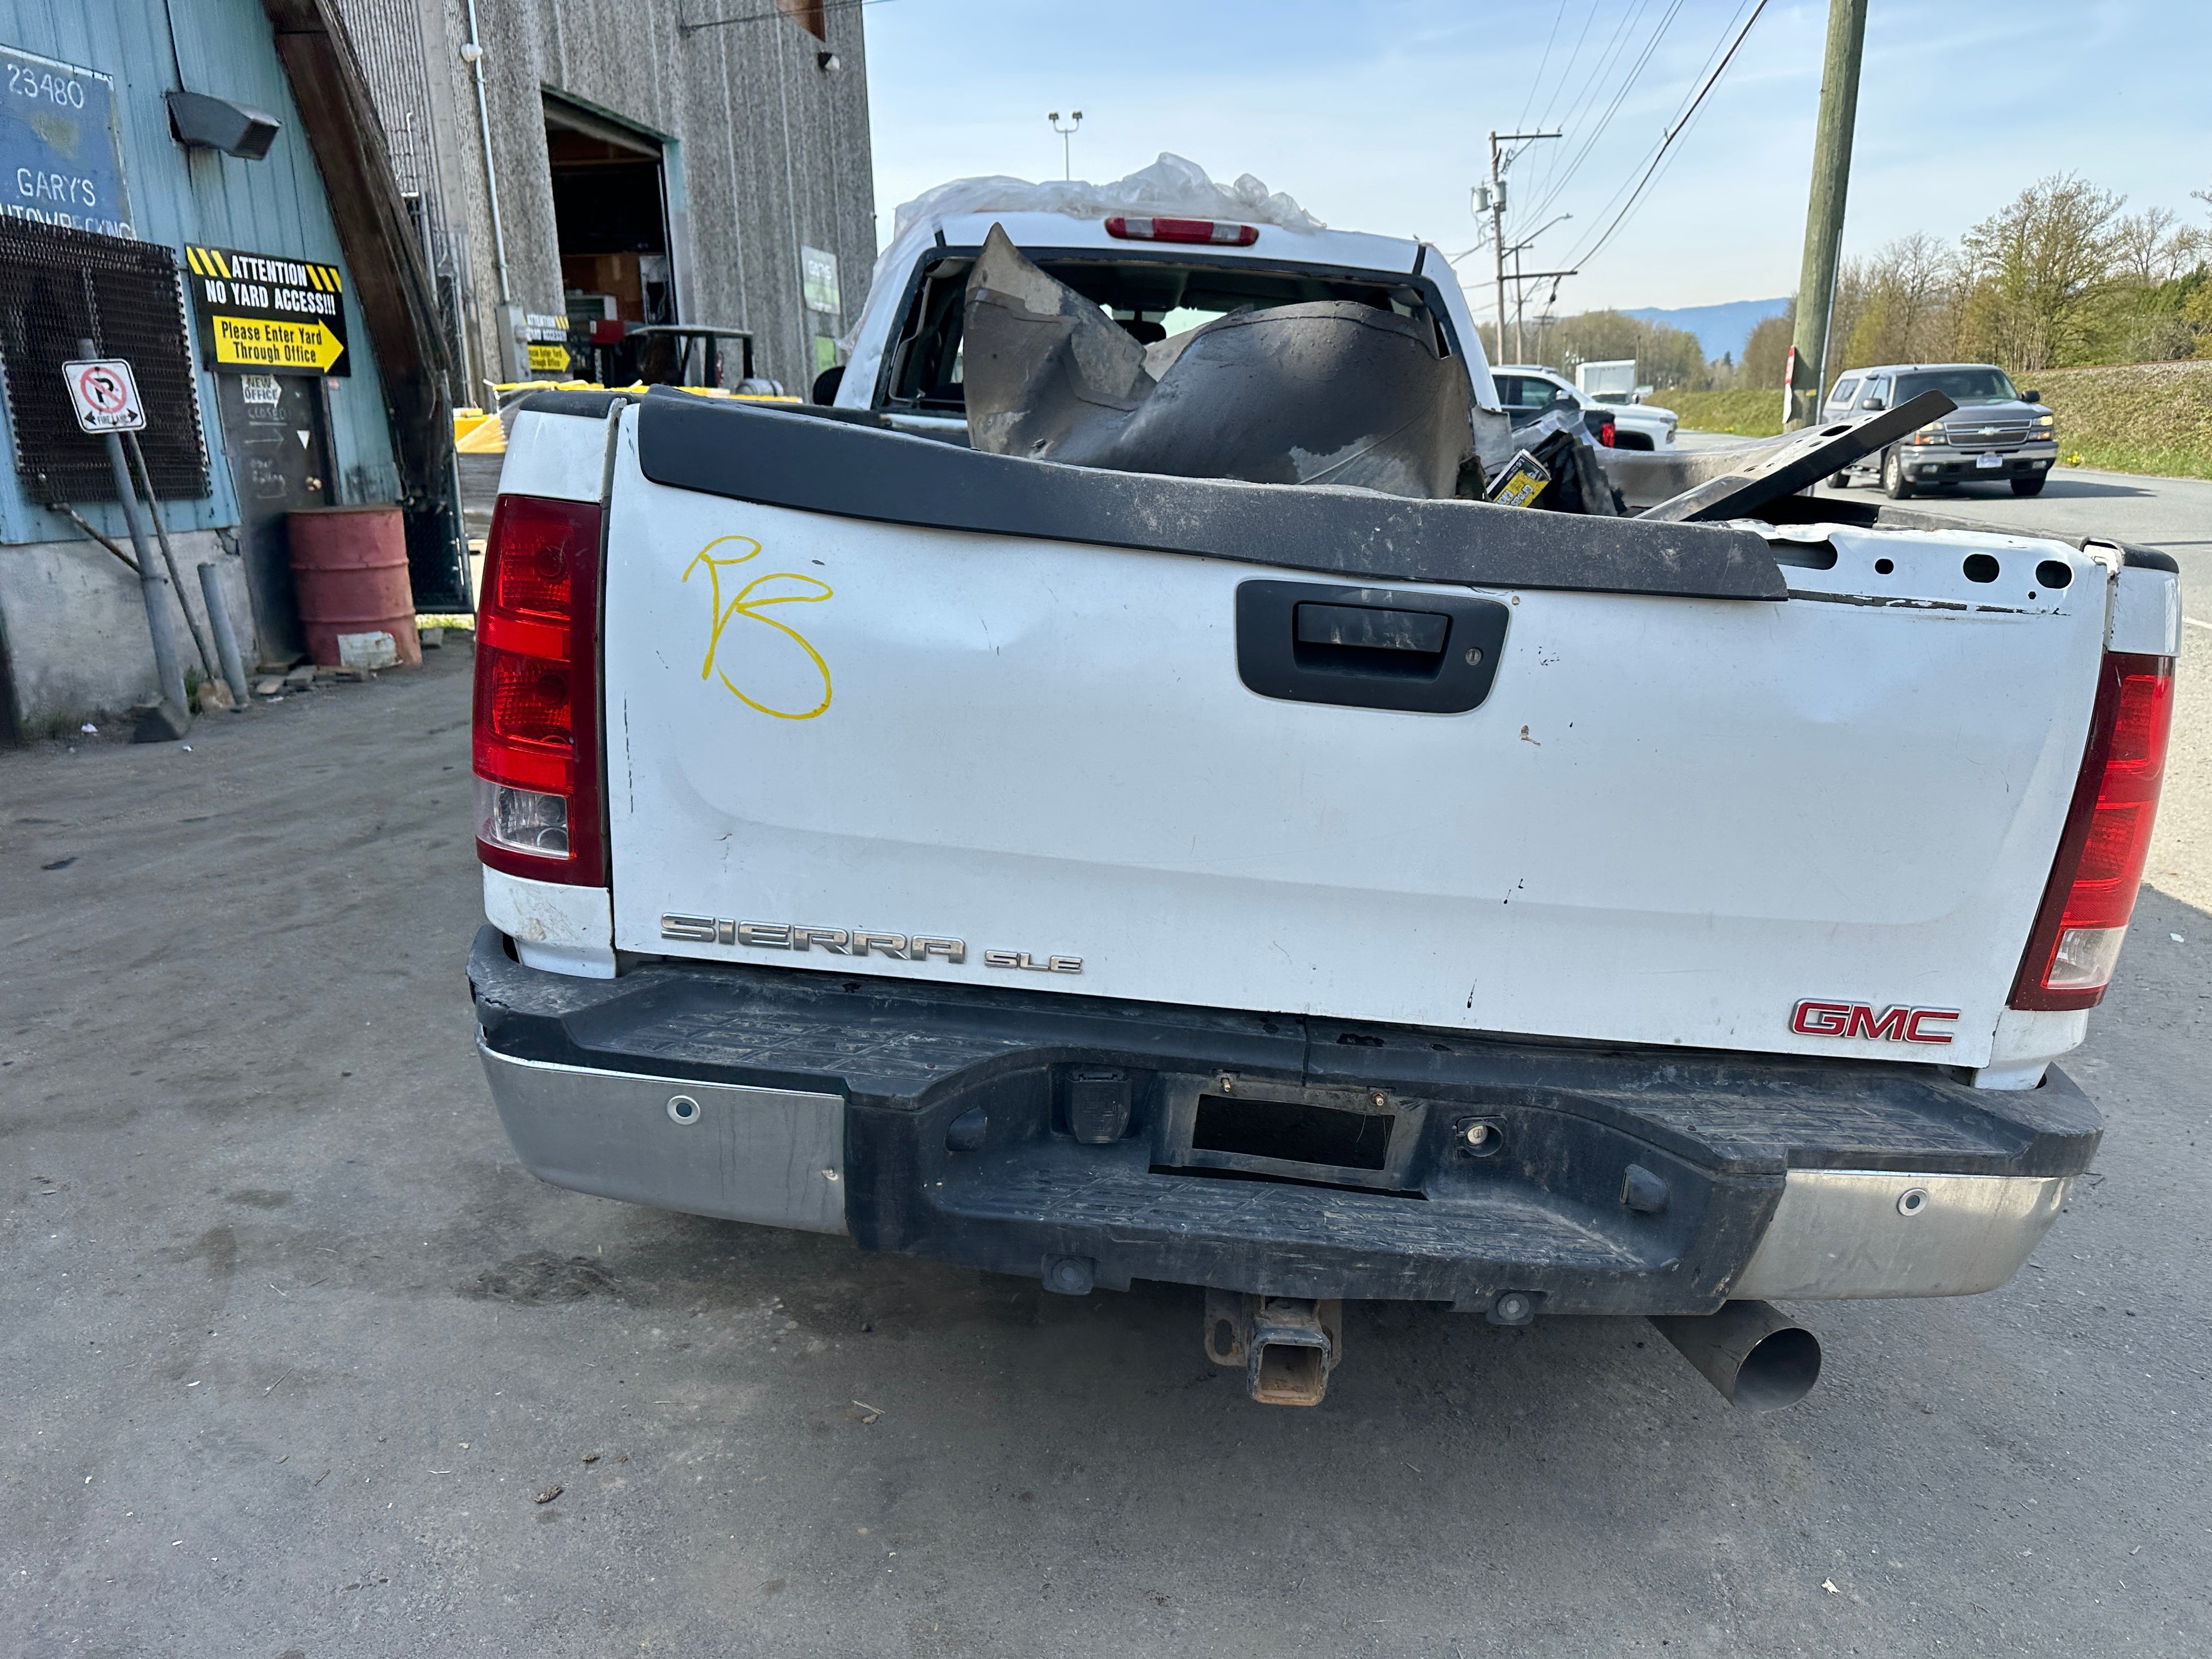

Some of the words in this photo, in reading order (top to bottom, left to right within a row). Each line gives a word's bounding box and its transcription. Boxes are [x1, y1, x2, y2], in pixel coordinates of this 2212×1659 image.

[7, 63, 85, 109] 23480
[17, 168, 96, 207] GARY'S
[232, 255, 308, 287] ATTENTION
[204, 279, 227, 305] NO
[231, 282, 268, 309] YARD
[274, 288, 336, 316] ACCESS!!!
[221, 321, 260, 341] Please
[265, 325, 294, 343] Enter
[298, 328, 323, 346] Yard
[233, 342, 280, 363] Through
[285, 346, 316, 363] Office
[244, 387, 278, 400] OFFICE
[97, 415, 110, 425] FIRE
[1510, 484, 1533, 506] Greas
[660, 911, 965, 964] SIERRA
[984, 949, 1083, 974] SLE
[1789, 997, 1962, 1044] GMC
